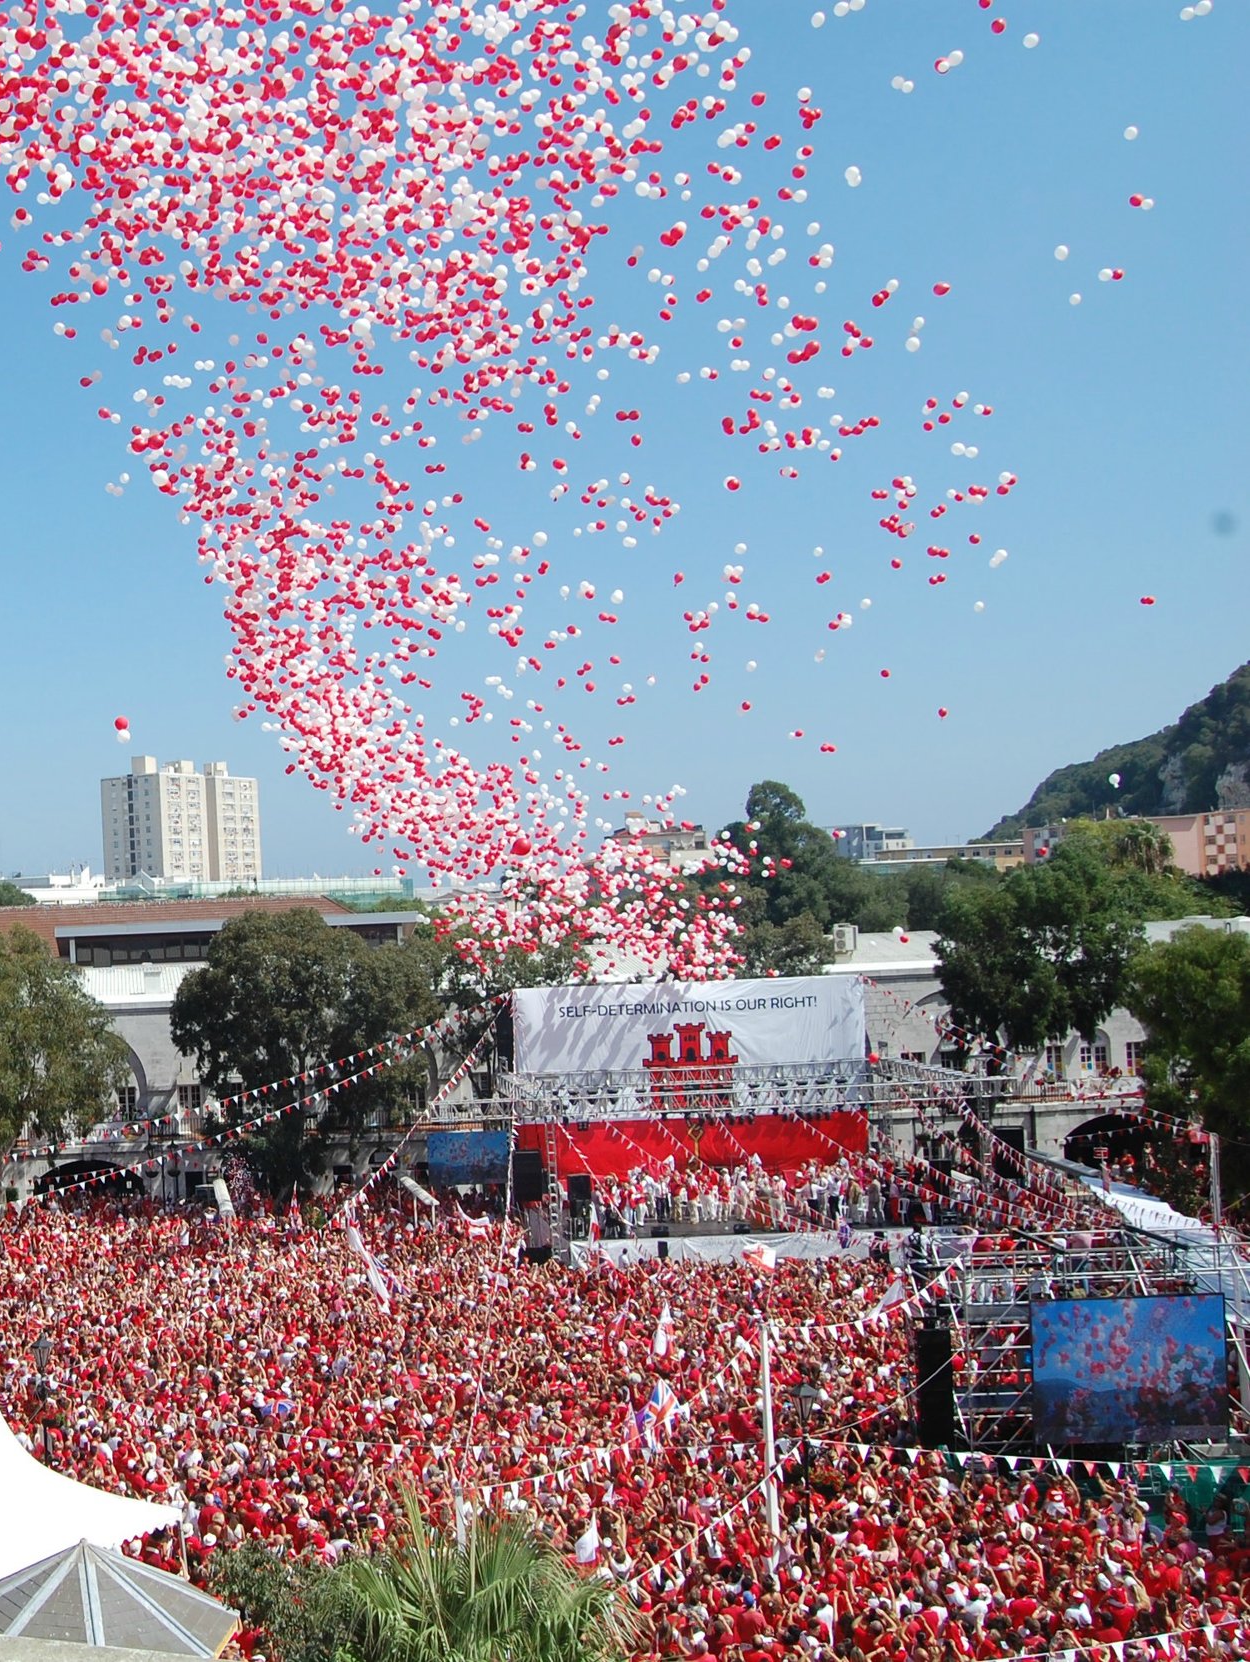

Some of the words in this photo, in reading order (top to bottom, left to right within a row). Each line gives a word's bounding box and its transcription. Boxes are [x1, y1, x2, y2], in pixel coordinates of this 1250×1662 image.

[559, 1001, 716, 1017] SELF-DETERMINATION
[721, 1000, 731, 1011] IS
[736, 998, 766, 1011] OUR
[770, 996, 817, 1009] RIGHT!
